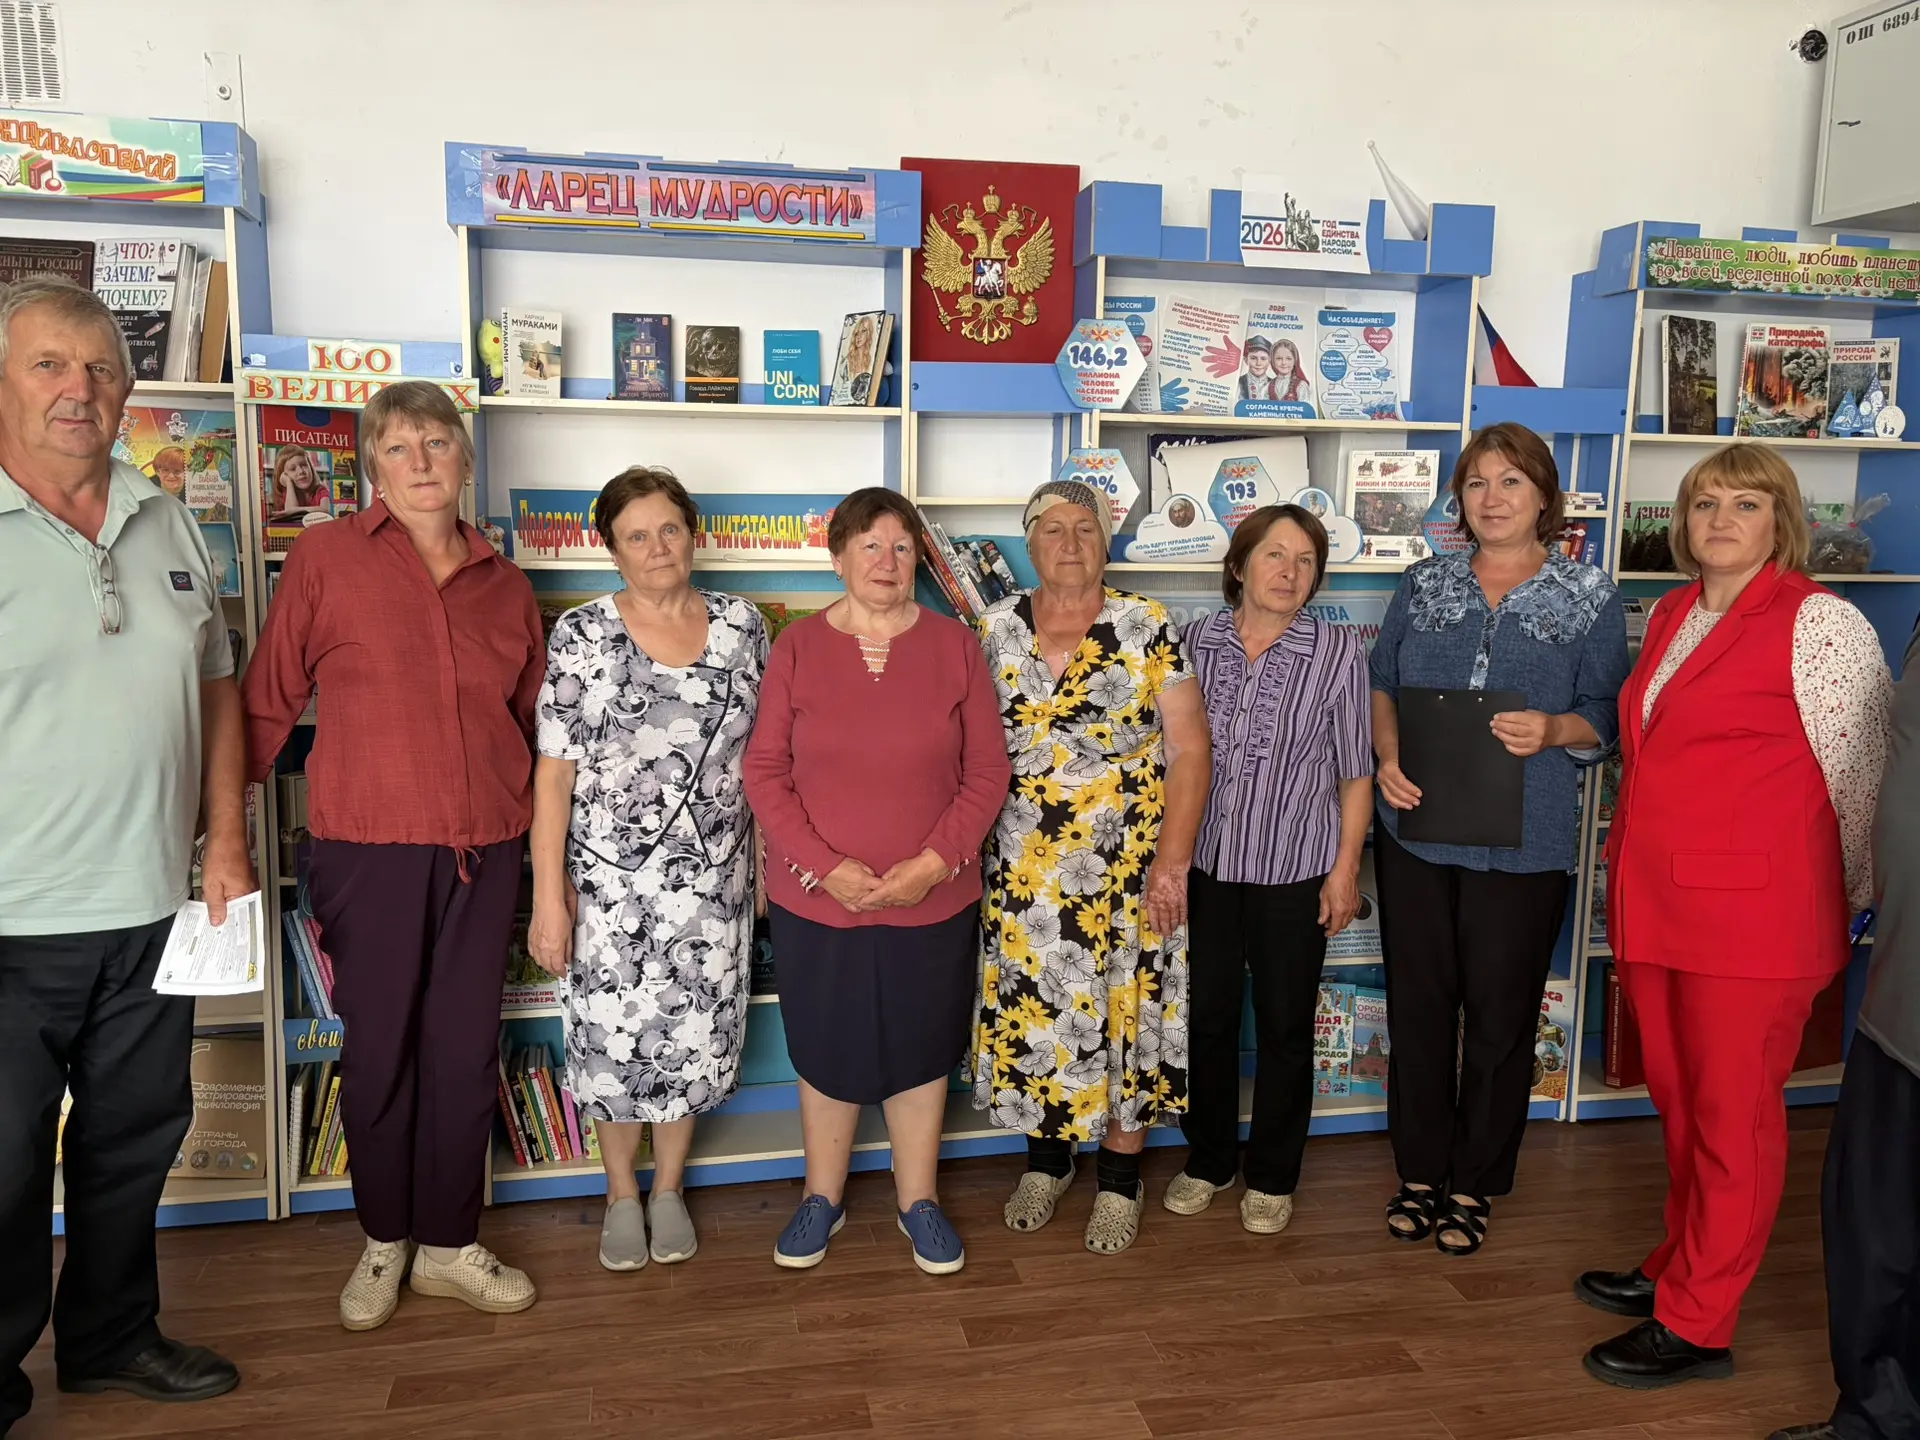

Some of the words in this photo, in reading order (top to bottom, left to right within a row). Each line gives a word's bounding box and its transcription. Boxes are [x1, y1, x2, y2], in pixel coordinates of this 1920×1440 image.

[0, 119, 177, 181] НЦИКЛОПЕДИЙ
[496, 168, 639, 217] «ЛАРЕЦ
[649, 176, 864, 227] МУДРОСТИ»
[1322, 220, 1337, 229] ГОД
[1241, 221, 1284, 246] 2026
[1322, 229, 1360, 239] ЕДИНСТВА
[1322, 239, 1356, 248] НАРОДОВ
[119, 242, 155, 260] ЧТО?
[1322, 247, 1353, 255] РОССИИ
[1746, 246, 1791, 266] люди,
[1798, 247, 1858, 268] любить
[37, 258, 83, 271] РОССИИ
[103, 266, 155, 283] ЗАЧЕМ?
[1656, 265, 1675, 278] во
[1681, 262, 1721, 279] всей
[1727, 267, 1810, 284] вселенной
[1816, 271, 1882, 288] похожей
[101, 289, 167, 307] ПОЧЕМУ?
[511, 318, 558, 331] МУРАКАМИ
[1266, 314, 1298, 322] ЕДИНСТВА
[1768, 327, 1825, 339] Природные
[1767, 338, 1827, 349] катастрофы
[1833, 346, 1876, 354] ПРИРОДА
[313, 345, 392, 373] 100
[1070, 344, 1128, 371] 146,2
[764, 370, 793, 385] UNI
[244, 375, 478, 408] ВЕЛИХ
[773, 384, 820, 399] CORN
[274, 428, 349, 447] ПИСАТЕЛИ
[1226, 481, 1257, 500] 193
[1232, 504, 1257, 512] ЭТНОСА
[1192, 535, 1216, 543] СООБЩА
[1314, 1050, 1348, 1058] АРОДОВ
[195, 1100, 261, 1112] нциклопедия
[193, 1130, 239, 1139] СТРАНЫ
[204, 1140, 247, 1148] ГОРОДА
